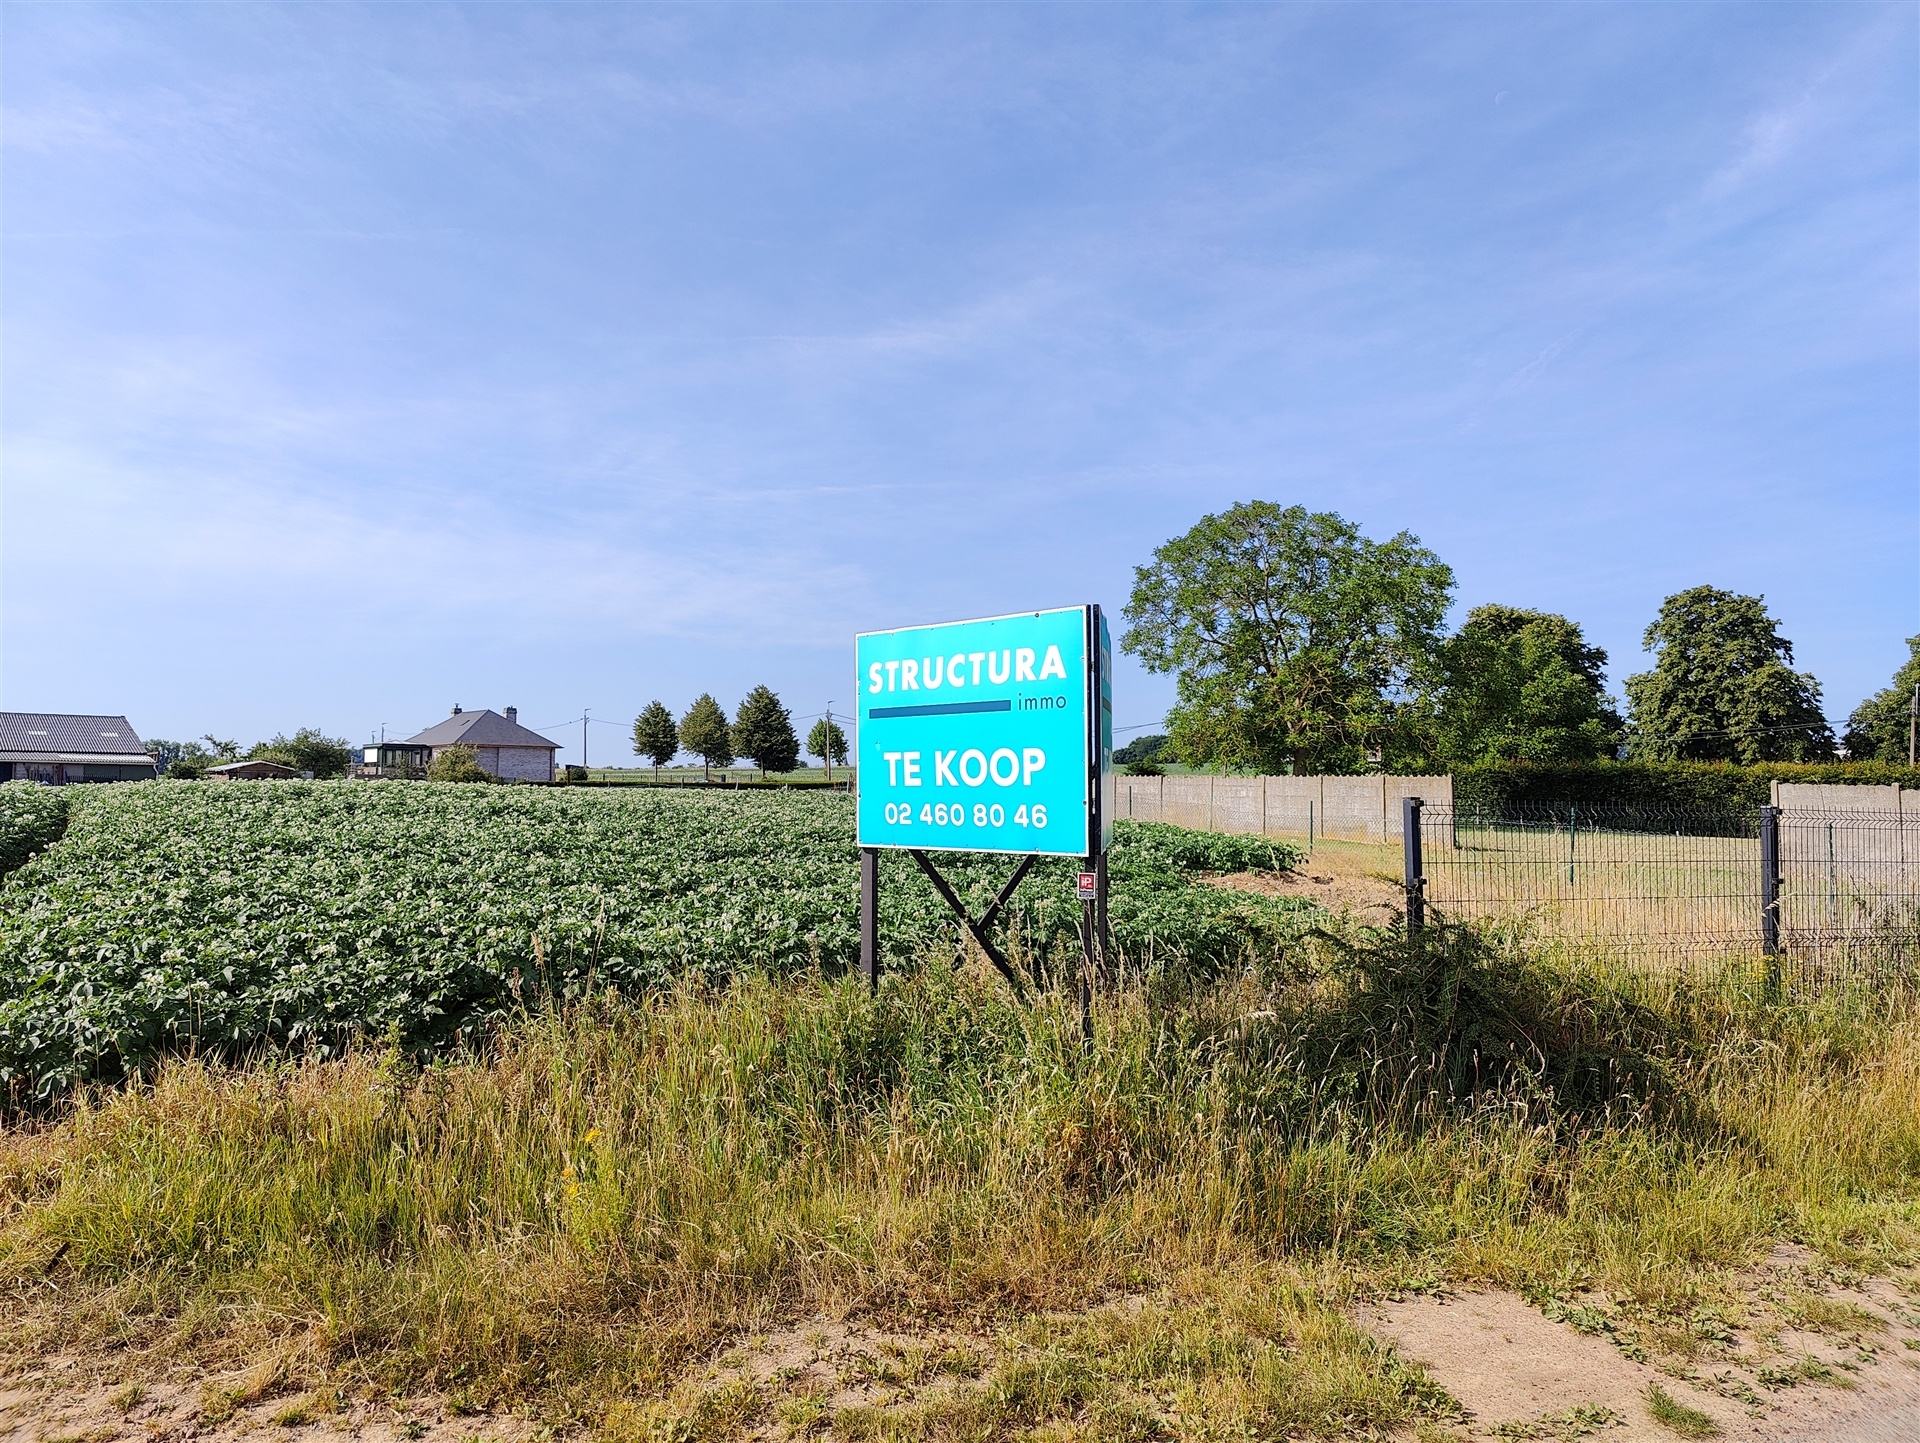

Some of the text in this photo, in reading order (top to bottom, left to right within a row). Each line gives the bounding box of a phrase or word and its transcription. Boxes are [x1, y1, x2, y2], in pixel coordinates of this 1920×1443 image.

[868, 644, 1067, 694] STRUCTURA
[1018, 693, 1067, 711] immo
[883, 747, 1046, 787] TE KOOP
[884, 802, 1048, 828] 02 460 80 46
